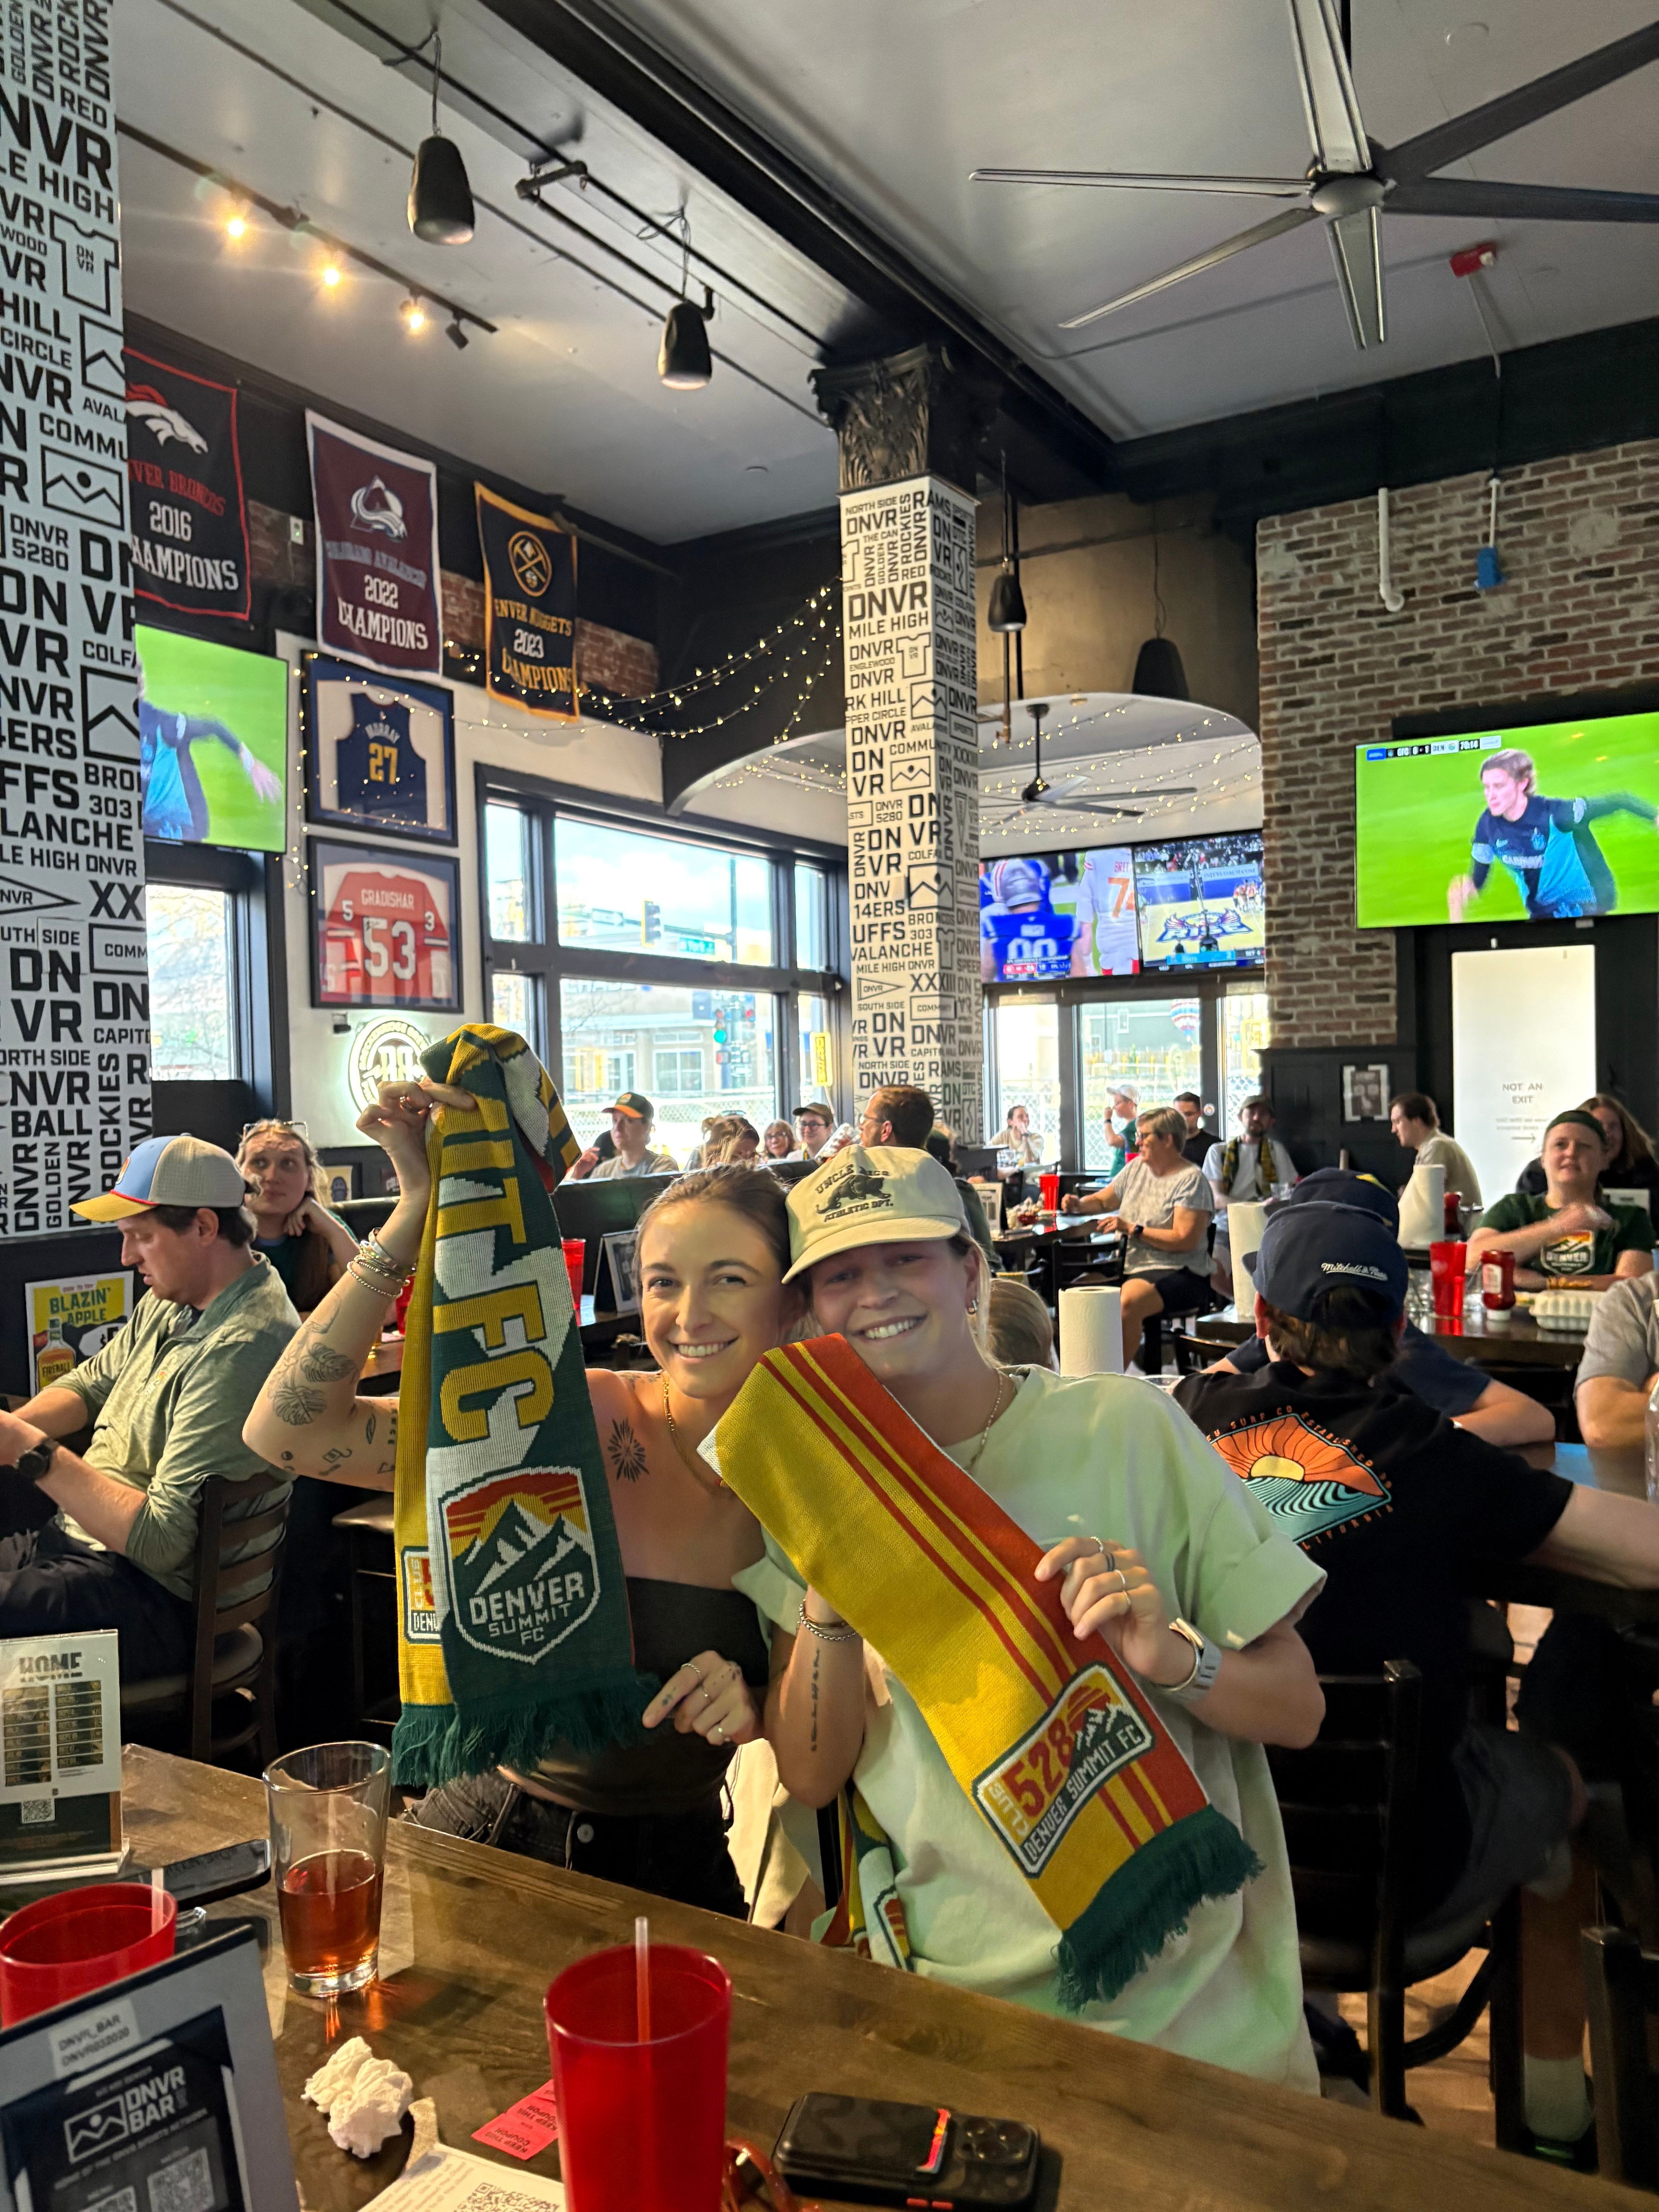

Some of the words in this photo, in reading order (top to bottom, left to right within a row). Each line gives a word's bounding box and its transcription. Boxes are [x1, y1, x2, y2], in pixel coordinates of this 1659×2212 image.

[30, 10, 54, 101] DNVR
[83, 0, 110, 103] DNVR
[60, 84, 107, 129] RED
[39, 163, 113, 224] HIGH
[1, 326, 72, 362] CIRCLE
[845, 502, 876, 517] NORTH
[876, 496, 897, 509] SIDE
[10, 513, 69, 548] DNVR
[149, 501, 192, 542] 2016
[847, 508, 897, 536] DNVR
[900, 493, 912, 565] ROCKIES
[863, 533, 879, 544] THE
[881, 529, 898, 540] CAN
[913, 510, 927, 562] DNVR
[12, 537, 69, 571] 5280
[864, 544, 875, 588] DNVR
[878, 543, 886, 584] GOLDEN
[888, 540, 898, 584] DNVR
[902, 565, 925, 581] RED
[364, 574, 399, 610] 2022
[848, 580, 928, 622] DNVR
[848, 619, 885, 639] MILE
[891, 610, 929, 629] HIGH
[849, 639, 894, 661] DNVR
[849, 657, 895, 672] ENGLEWOOD
[850, 668, 894, 690] DNVR
[871, 687, 906, 708] HILL
[871, 707, 906, 721] CIRCLE
[852, 719, 906, 747] DNVR
[369, 742, 398, 786] 27
[852, 747, 884, 773] DN
[852, 773, 884, 798] VR
[89, 795, 132, 820] 303
[876, 799, 903, 812] DNVR
[876, 811, 903, 823] 5280
[908, 792, 940, 819] DN
[1, 807, 133, 852] LANCHE
[868, 826, 902, 851] DN
[908, 820, 941, 847] VR
[944, 795, 953, 861] DNVR
[31, 847, 79, 872] HIGH
[86, 854, 137, 877] DNVR
[854, 831, 866, 878] DNVR
[868, 852, 902, 878] VR
[342, 899, 354, 922] 5
[361, 889, 415, 910] GRADISHAR
[854, 899, 905, 920] 14ERS
[424, 910, 435, 931] 3
[42, 929, 80, 946] SIDE
[910, 929, 933, 940] 303
[362, 916, 417, 981] 53
[10, 947, 81, 994] DN
[856, 963, 879, 974] MILE
[881, 962, 905, 972] HIGH
[908, 960, 935, 970] DNVR
[93, 981, 149, 1022] DN
[863, 984, 884, 993] DNVR
[857, 1003, 885, 1012] SOUTH
[886, 1001, 905, 1010] SIDE
[11, 998, 83, 1043] VR
[872, 1011, 905, 1034] DN
[50, 1049, 91, 1066] SIDE
[873, 1036, 905, 1058] VR
[859, 1061, 888, 1070] NORTH
[889, 1060, 910, 1069] SIDE
[859, 1071, 909, 1089] DNVR
[943, 1082, 961, 1105] DN
[1502, 1083, 1523, 1091] NOT
[1528, 1083, 1543, 1091] AN
[1512, 1096, 1534, 1104] EXIT
[12, 1109, 92, 1138] BALL
[13, 1142, 38, 1233] DNVR
[45, 1142, 62, 1229] GOLDEN
[815, 1164, 854, 1194] UNCLE
[824, 1202, 869, 1223] ATHLETIC
[1321, 1262, 1362, 1273] Mitchell
[49, 1287, 112, 1315] BLAZIN'
[67, 1308, 106, 1325] APPLE
[469, 1571, 585, 1626] DENVER
[489, 1602, 572, 1638] SUMMIT
[520, 1627, 546, 1645] FC
[1024, 1798, 1068, 1862] DENVER
[1066, 1740, 1117, 1801] SUMMIT
[1115, 1724, 1142, 1749] FC
[987, 1781, 1030, 1837] CLUB
[125, 2065, 186, 2112] DNVR
[129, 2094, 175, 2134] BAR
[495, 2128, 531, 2146] COUPON
[504, 2140, 528, 2154] KEEP
